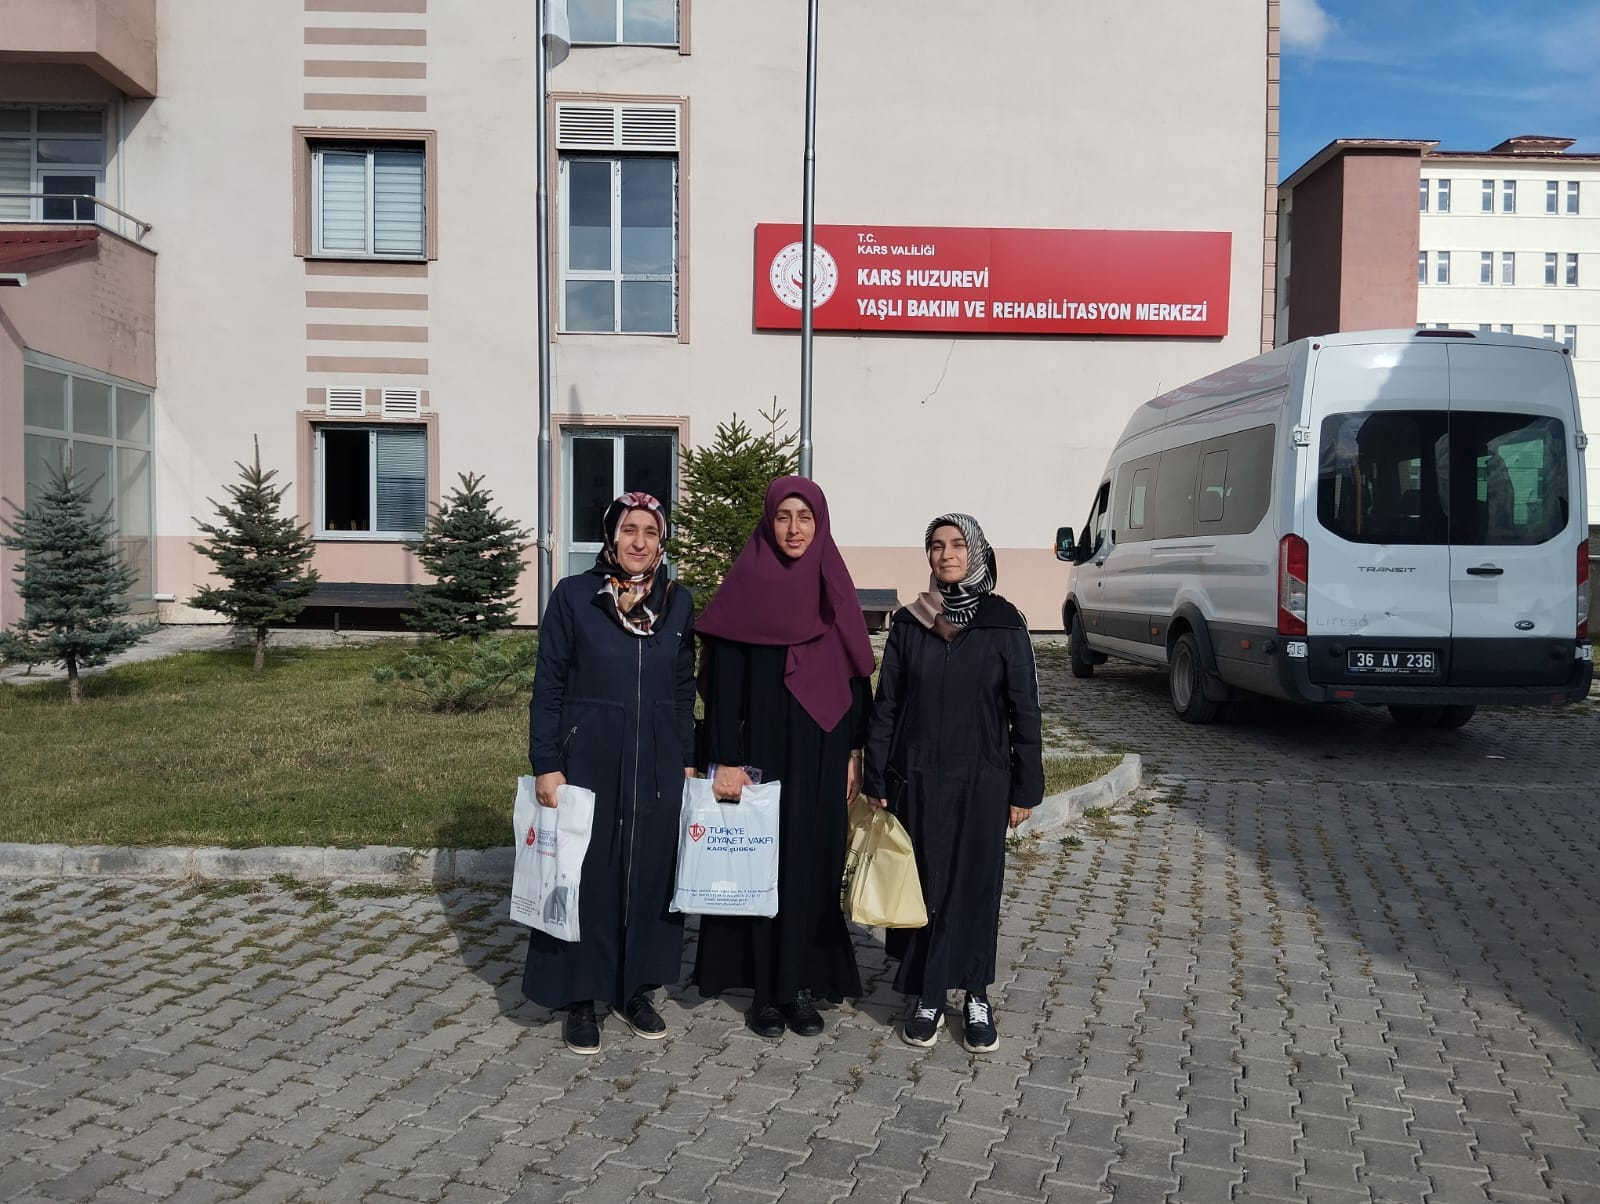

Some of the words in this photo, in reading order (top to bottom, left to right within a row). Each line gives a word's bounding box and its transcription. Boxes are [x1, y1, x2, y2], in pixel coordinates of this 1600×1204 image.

[857, 233, 877, 243] T.C.
[857, 245, 888, 255] KARS
[891, 244, 935, 256] VALİLİĞİ
[857, 268, 902, 286] KARS
[906, 267, 989, 288] HUZUREVİ
[857, 299, 902, 320] YAŞLI
[907, 300, 959, 317] BAKIM
[964, 301, 986, 318] VE
[992, 299, 1131, 320] REHABİLİTASYON
[1136, 301, 1208, 321] MERKEZİ
[1357, 653, 1374, 666] 36
[1382, 653, 1399, 667] AV
[1406, 654, 1432, 668] 236
